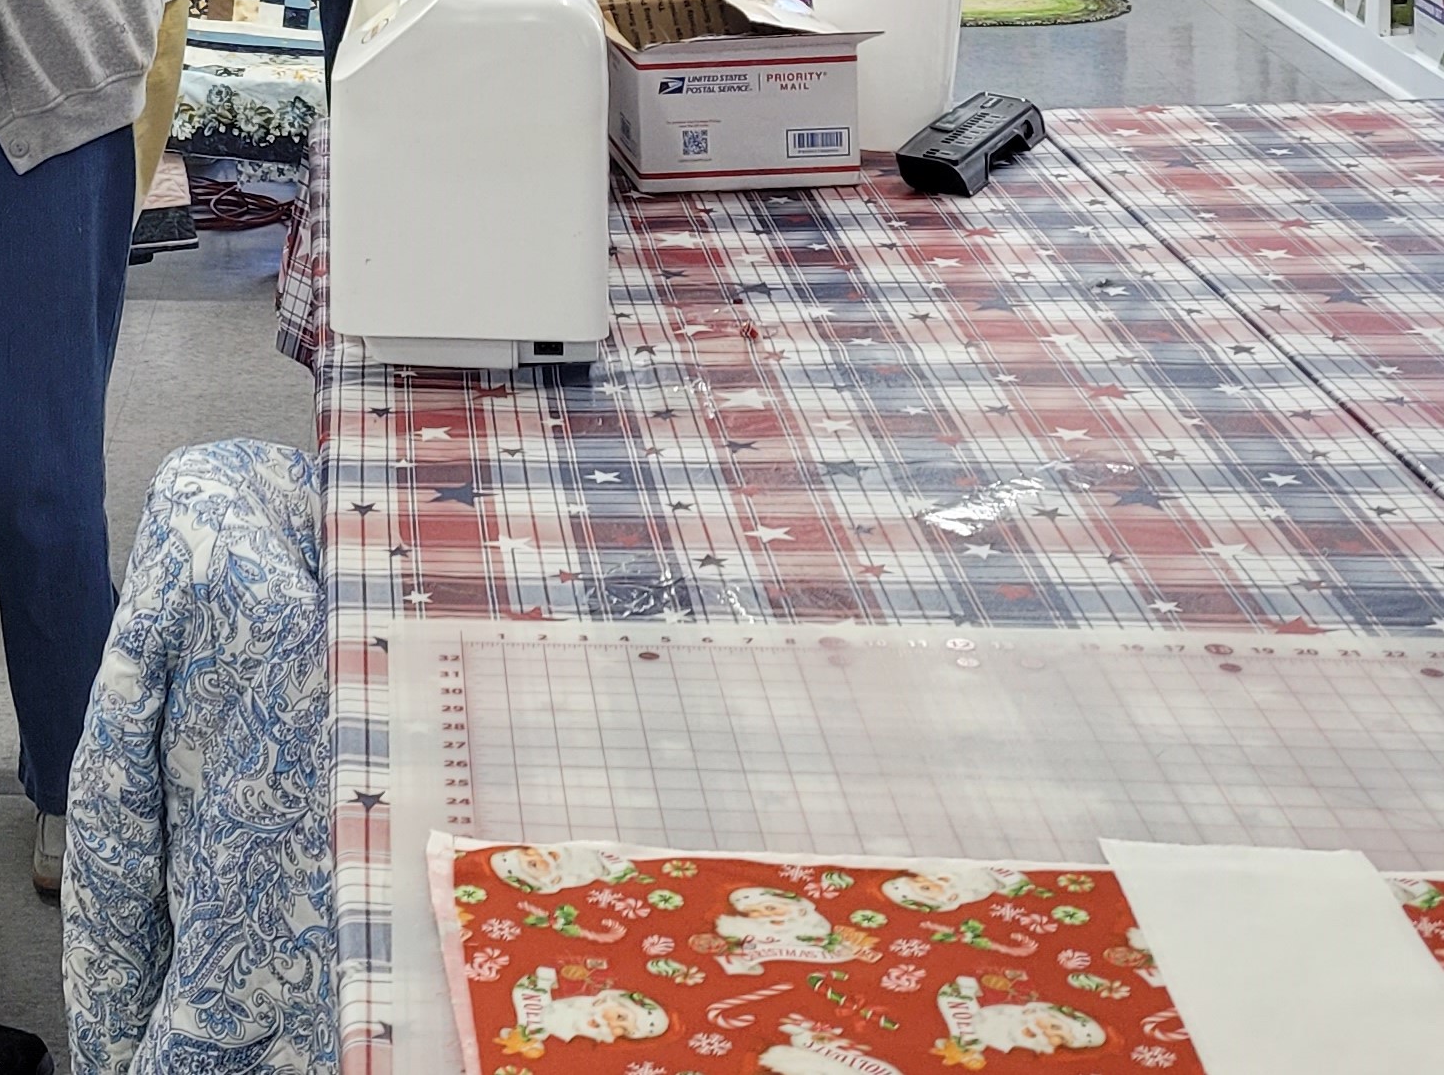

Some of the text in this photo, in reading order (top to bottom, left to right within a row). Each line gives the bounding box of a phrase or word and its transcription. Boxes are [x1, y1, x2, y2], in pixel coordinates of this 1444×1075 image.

[687, 74, 749, 83] UNITED STATES
[685, 84, 750, 95] POSTAL SERVICE
[780, 83, 810, 91] MAIL
[1294, 648, 1319, 656] 20
[1337, 649, 1361, 657] 21
[1382, 650, 1406, 658] 22
[442, 741, 466, 749] 27
[445, 778, 469, 787] 25
[446, 797, 471, 805] 24
[447, 816, 471, 824] 23
[947, 1001, 975, 1036] NOEL
